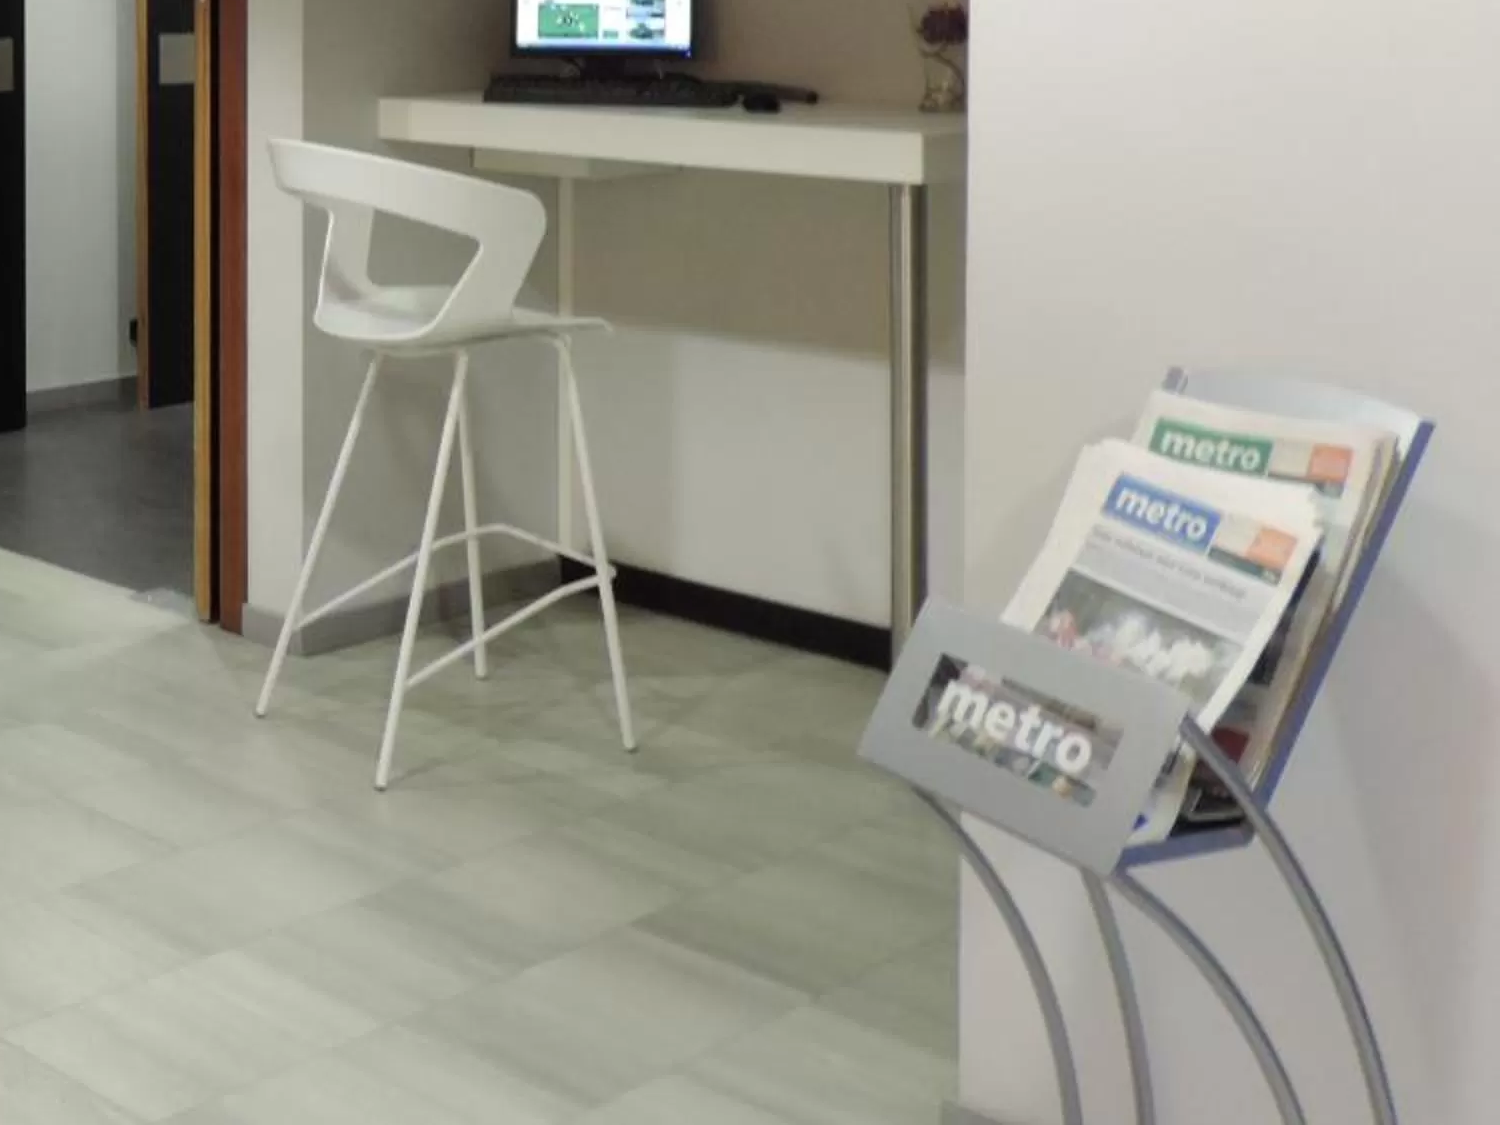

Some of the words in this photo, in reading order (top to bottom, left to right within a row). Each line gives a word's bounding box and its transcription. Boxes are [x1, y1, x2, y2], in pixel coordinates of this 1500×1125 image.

[1160, 429, 1260, 471] metro
[1115, 486, 1206, 539] metro
[935, 680, 1092, 775] metro
